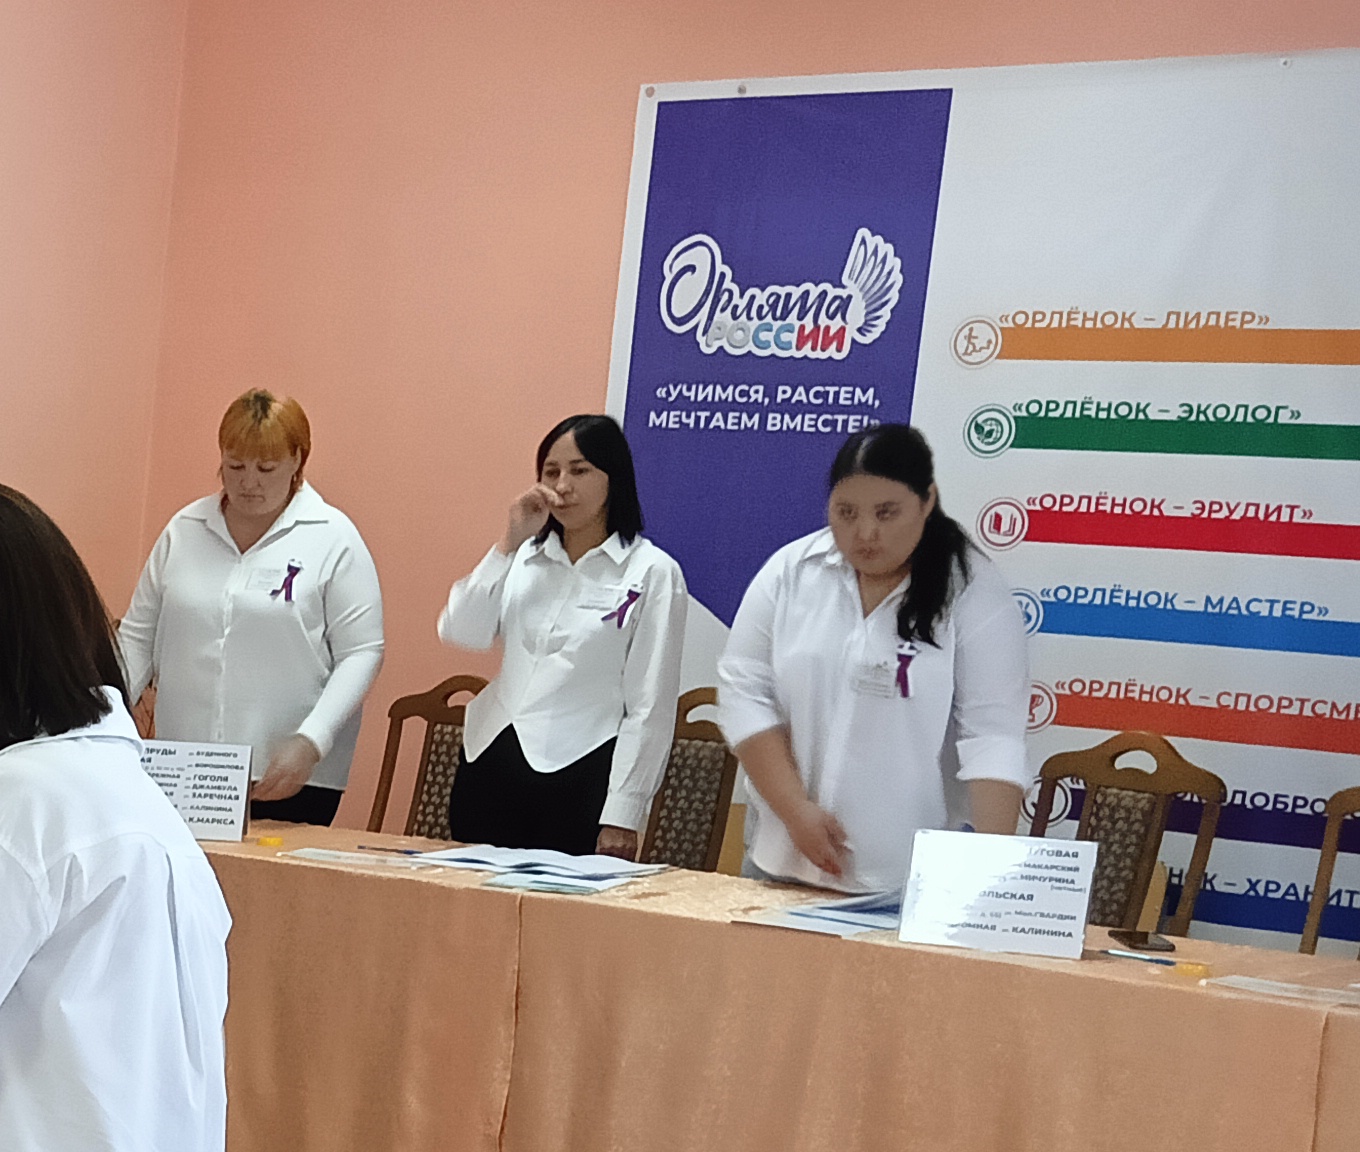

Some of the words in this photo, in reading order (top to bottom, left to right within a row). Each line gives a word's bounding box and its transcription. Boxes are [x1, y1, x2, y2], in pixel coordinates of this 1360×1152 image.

[999, 306, 1138, 330] «ОРЛЁНОК
[1161, 309, 1270, 330] ЛИДЕР»
[705, 321, 847, 352] РОССИИ
[655, 383, 771, 407] «УЧИМСЯ,
[776, 385, 881, 409] РАСТЕМ,
[1012, 395, 1151, 420] «ОРЛЁНОК
[1176, 402, 1302, 424] ЭКОЛОГ»
[648, 410, 760, 430] МЕЧТАЕМ
[1026, 490, 1166, 517] «ОРЛЁНОК
[1190, 498, 1314, 524] ЭРУДИТ»
[1040, 584, 1180, 610] «ОРЛЁНОК
[1202, 593, 1330, 620] МАСТЕР»
[1054, 677, 1193, 706] «ОРЛЁНОК
